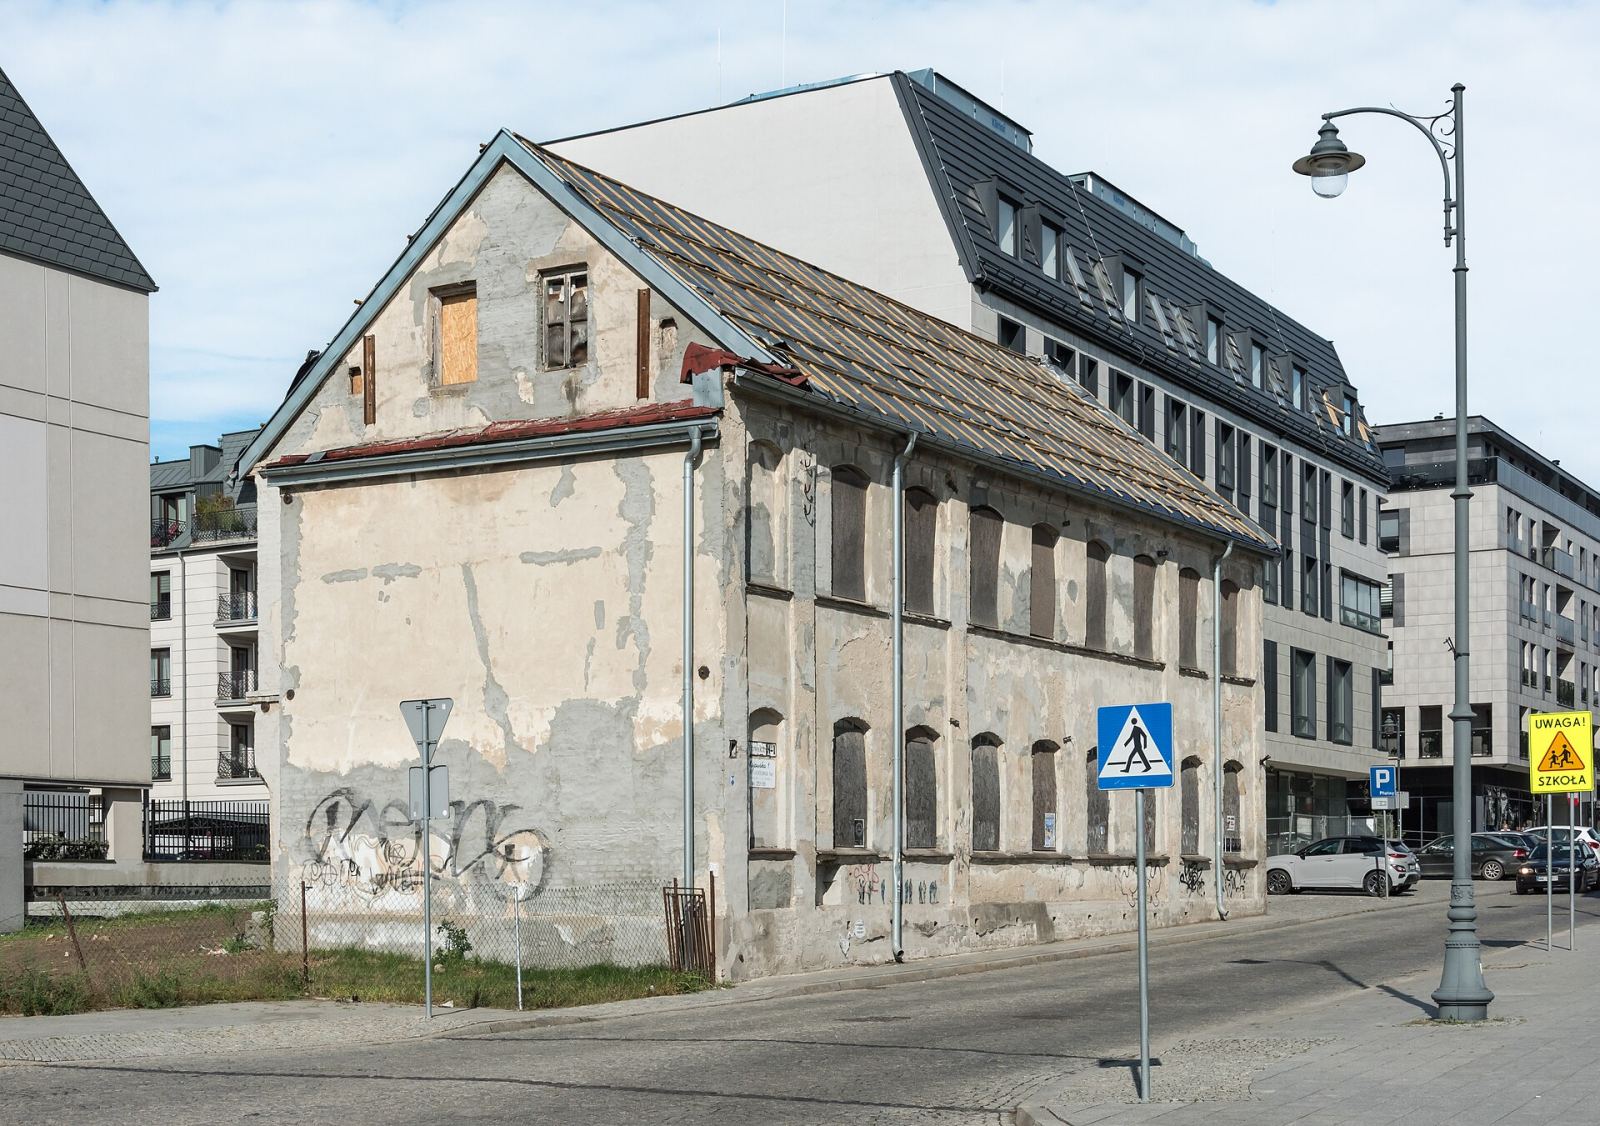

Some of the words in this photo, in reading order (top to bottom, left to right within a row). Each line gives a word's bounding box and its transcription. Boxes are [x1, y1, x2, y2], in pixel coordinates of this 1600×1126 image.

[1535, 717, 1586, 729] UWAGA!
[1375, 769, 1390, 789] P
[1538, 775, 1586, 786] SZKOŁA
